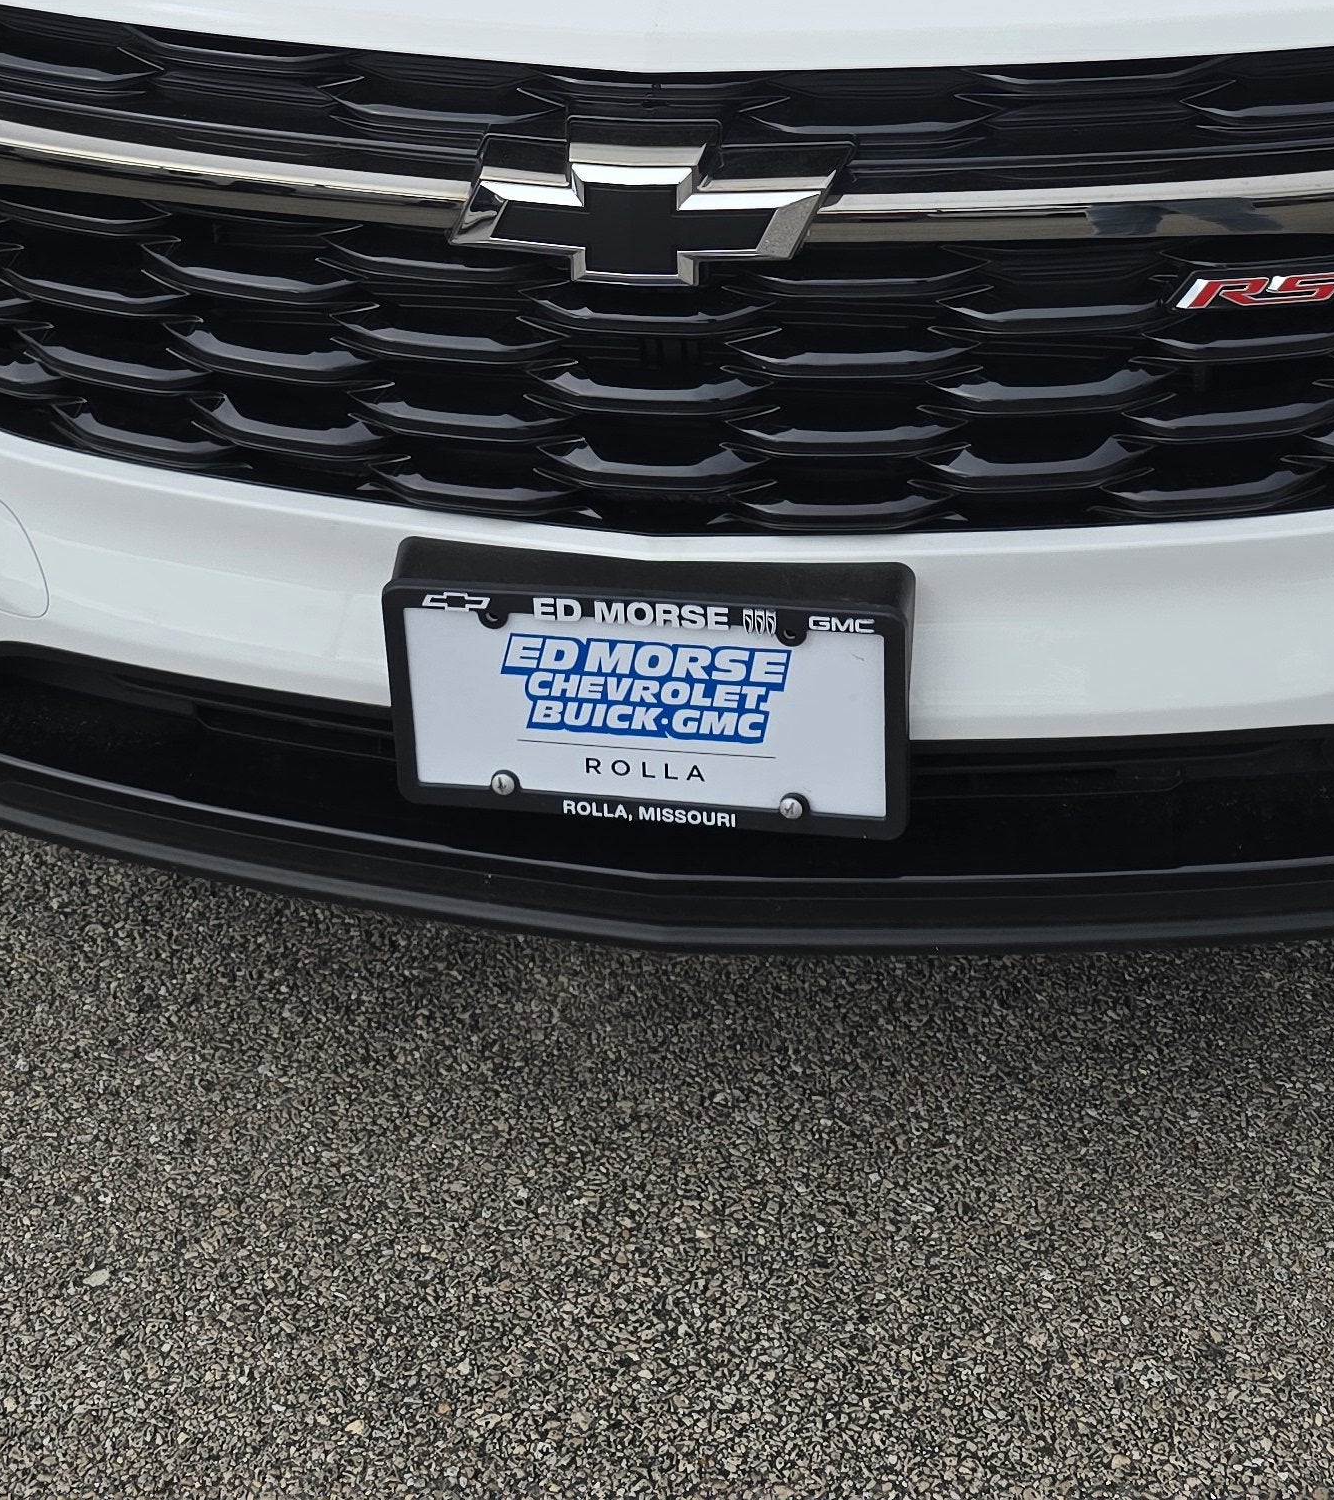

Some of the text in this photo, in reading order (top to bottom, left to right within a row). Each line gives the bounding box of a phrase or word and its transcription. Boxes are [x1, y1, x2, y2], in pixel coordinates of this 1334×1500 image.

[533, 597, 730, 631] ED MORSE
[808, 615, 876, 634] GMC
[506, 635, 788, 684] ED MORSE
[528, 671, 768, 711] CHEVROLET
[585, 757, 706, 782] ROLLA
[562, 800, 737, 829] ROLLA, MISSOURI
